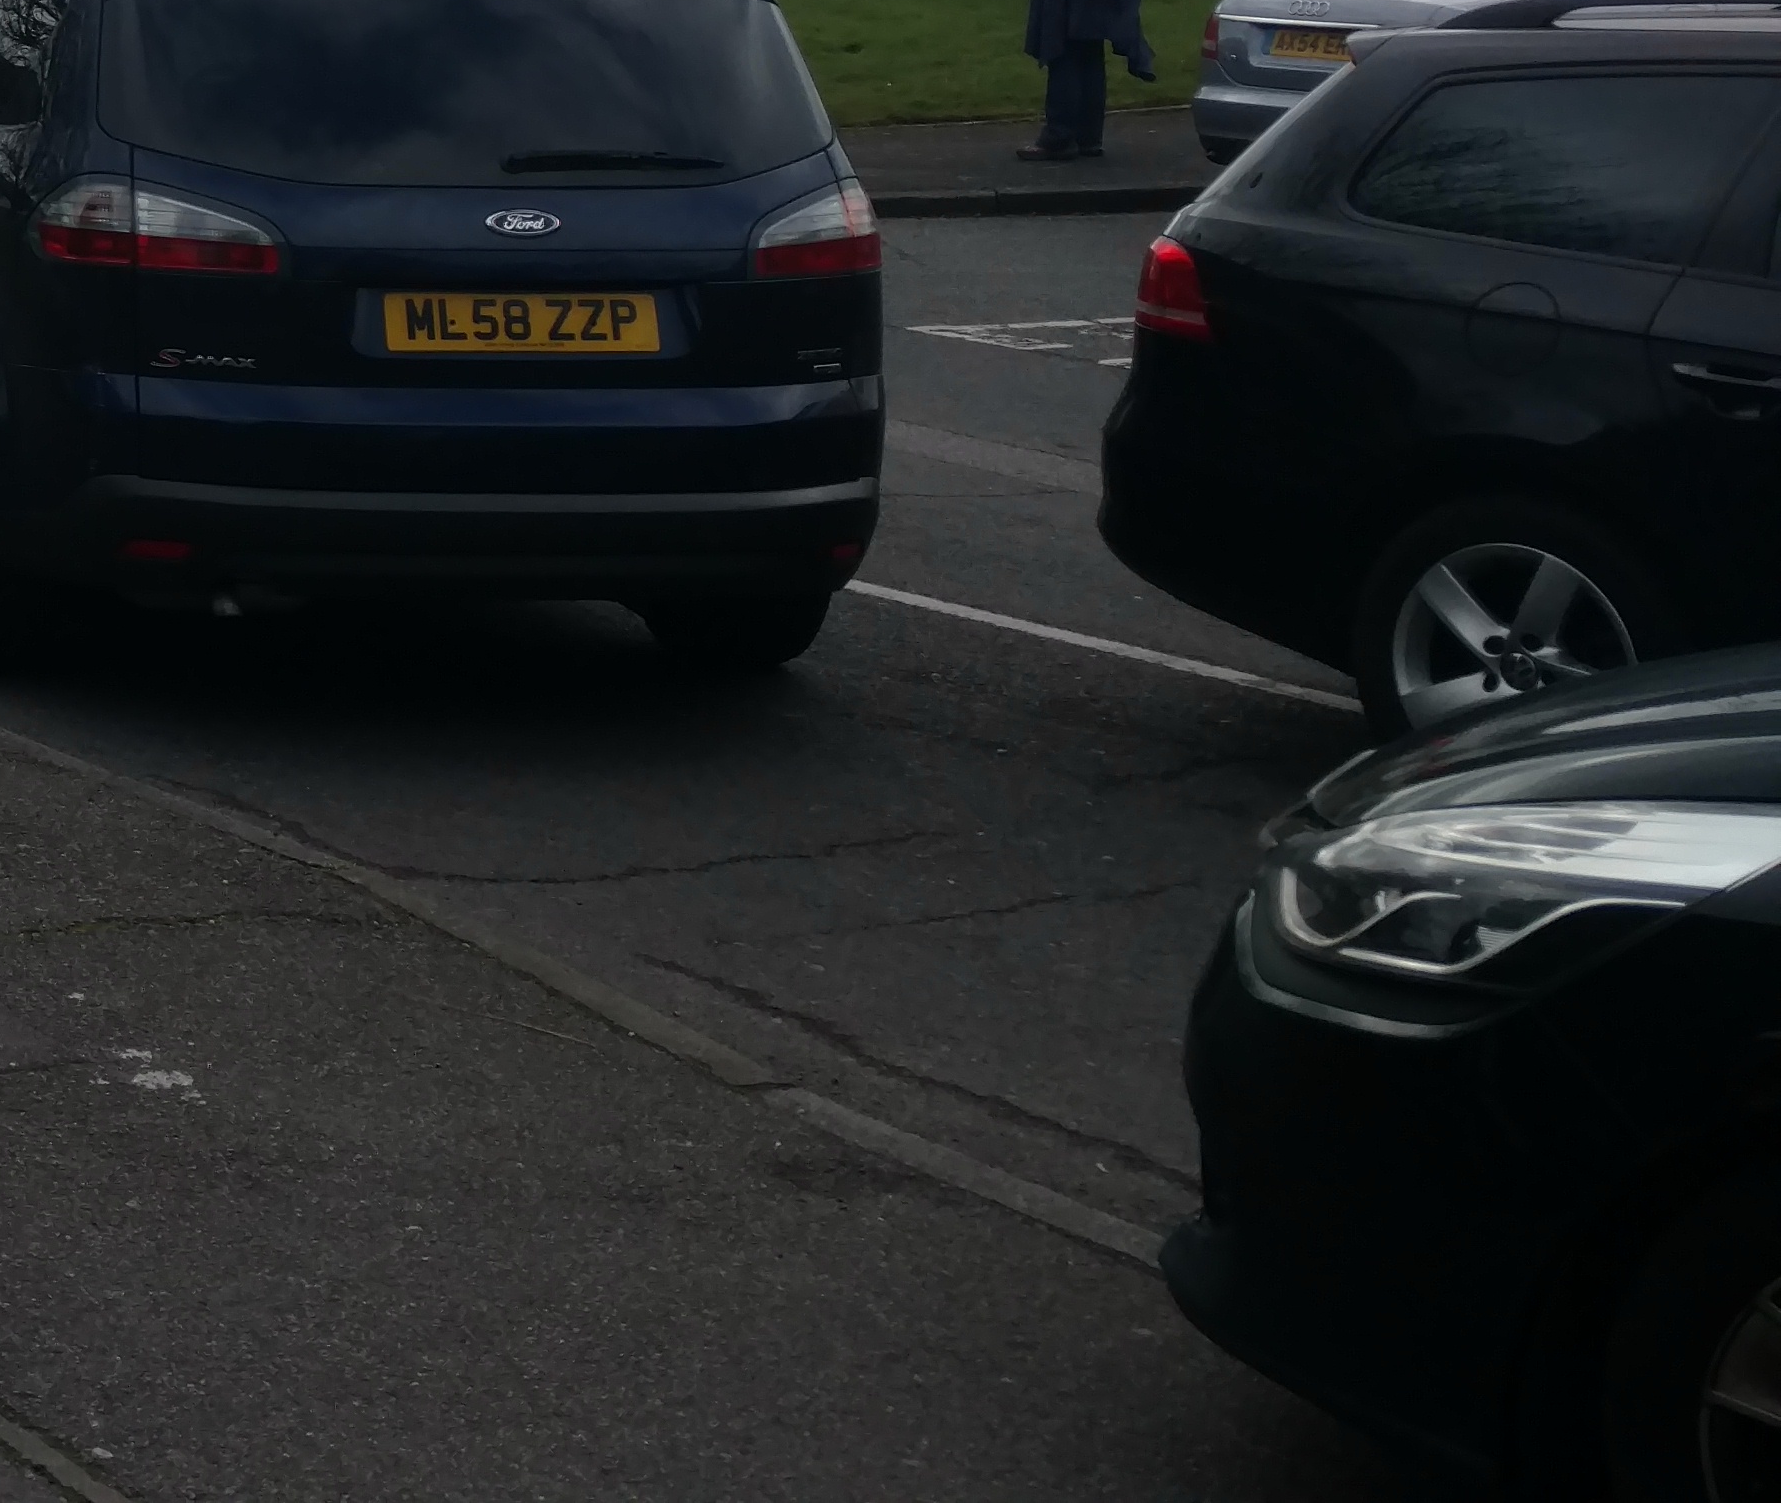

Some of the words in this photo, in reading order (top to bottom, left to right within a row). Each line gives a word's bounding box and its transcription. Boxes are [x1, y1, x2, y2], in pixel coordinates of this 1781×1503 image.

[503, 212, 545, 230] Ford
[404, 298, 532, 341] ML58
[544, 298, 638, 341] ZZP
